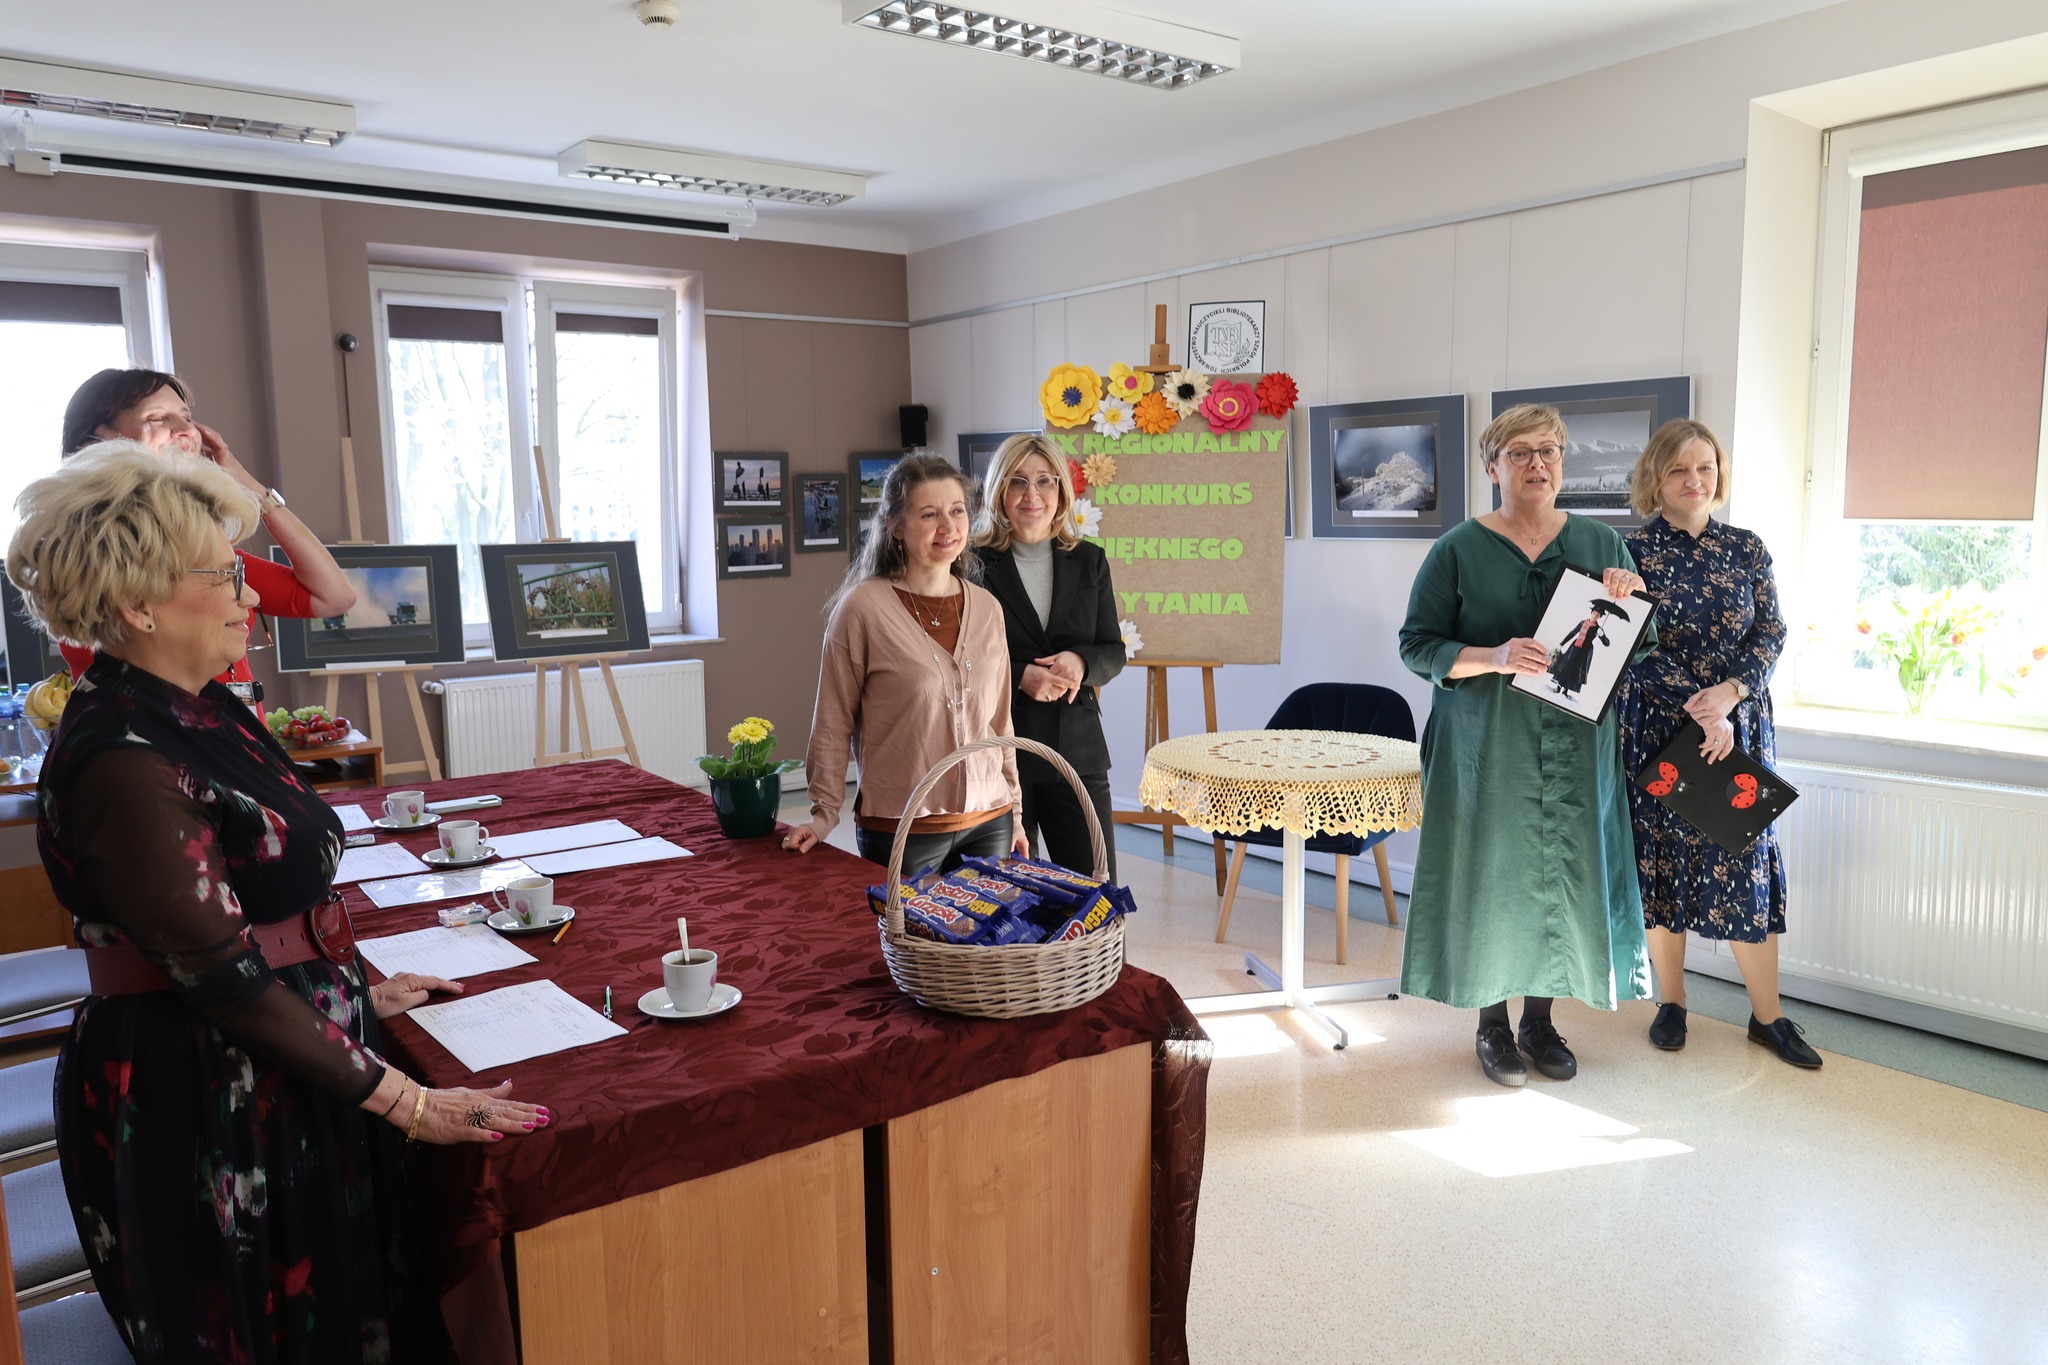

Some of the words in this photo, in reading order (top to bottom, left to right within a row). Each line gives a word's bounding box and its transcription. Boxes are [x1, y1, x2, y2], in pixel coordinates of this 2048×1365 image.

[1193, 307, 1225, 336] NAUCZYCIELI
[1226, 307, 1261, 338] BIBLIOTEKARZY
[1191, 337, 1217, 373] TOWARZYSTWO
[1250, 340, 1261, 359] SZKÓŁ
[1220, 357, 1251, 374] POLSKICH
[1082, 430, 1285, 455] REGIONALNY
[1095, 482, 1254, 506] KONKURS
[899, 883, 919, 899] EGA
[966, 899, 1000, 917] MEGA
[1083, 894, 1113, 933] MEGA
